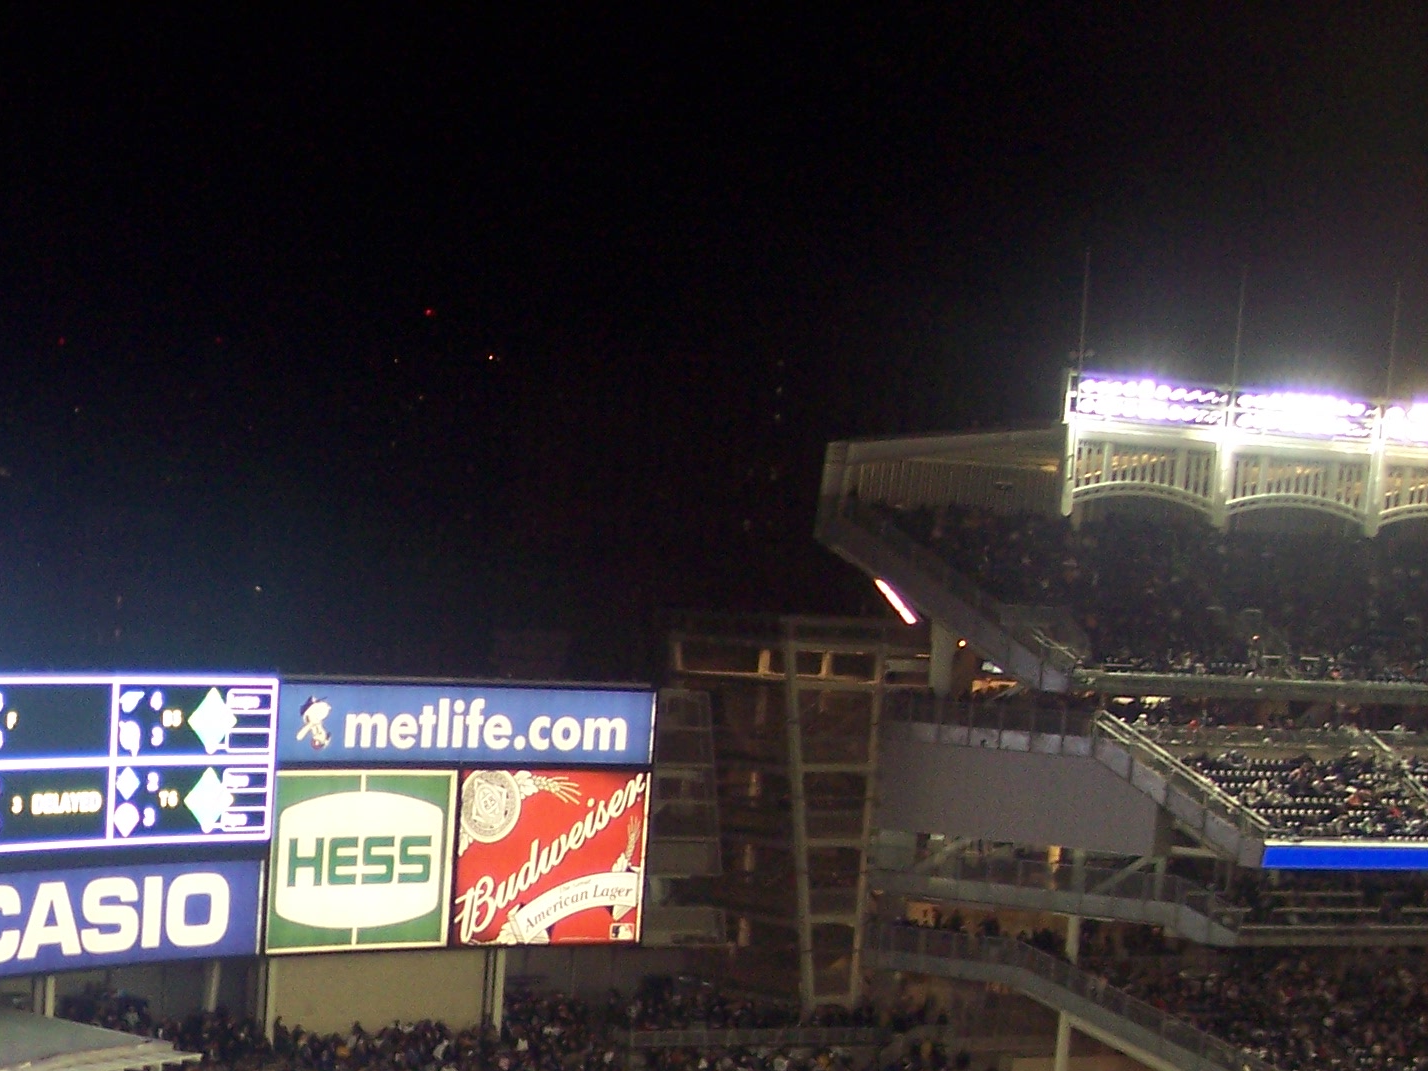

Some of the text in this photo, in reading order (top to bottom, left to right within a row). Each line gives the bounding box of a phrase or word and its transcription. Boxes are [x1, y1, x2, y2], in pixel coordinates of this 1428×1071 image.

[344, 697, 628, 751] metlife.com
[31, 791, 103, 815] DELAYED
[286, 835, 433, 887] HESS
[454, 773, 646, 943] Budweiser
[524, 884, 634, 934] American Lager
